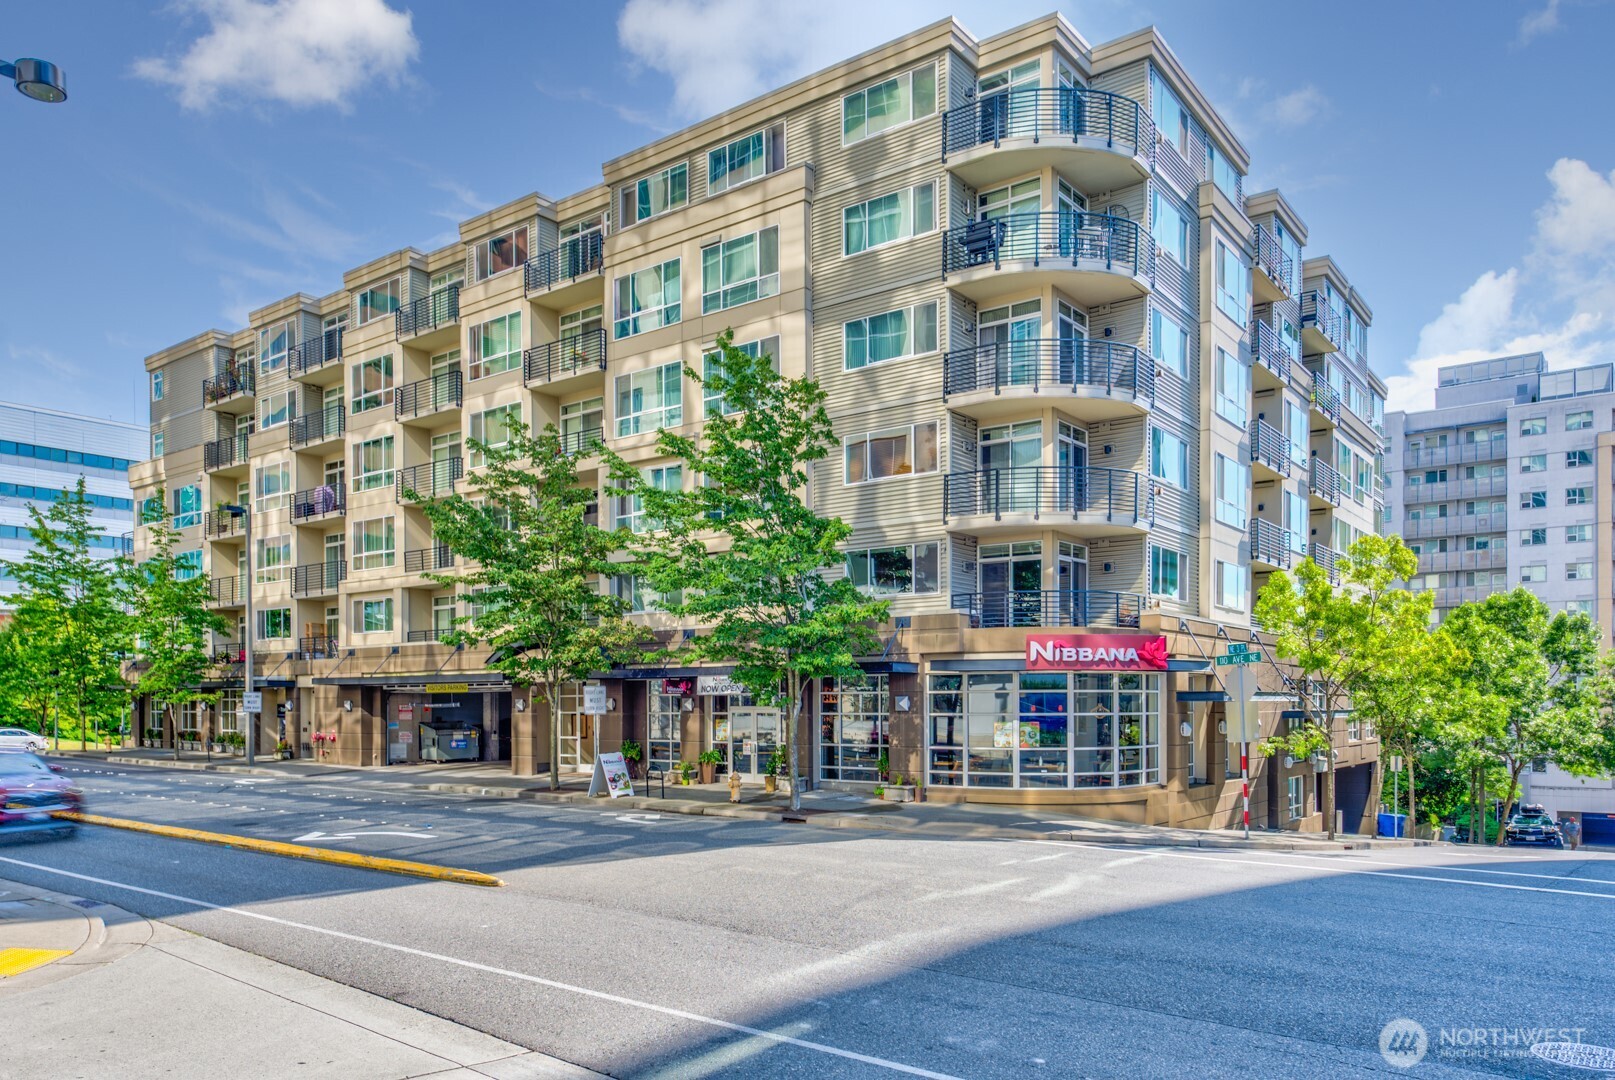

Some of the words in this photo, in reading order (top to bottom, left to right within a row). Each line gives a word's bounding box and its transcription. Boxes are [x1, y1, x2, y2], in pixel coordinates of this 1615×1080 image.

[1233, 655, 1245, 664] AVE
[1249, 653, 1258, 662] NE
[427, 684, 447, 692] VISITORS
[448, 683, 468, 691] PARKING
[701, 685, 720, 693] NOW
[721, 684, 742, 693] OPEN
